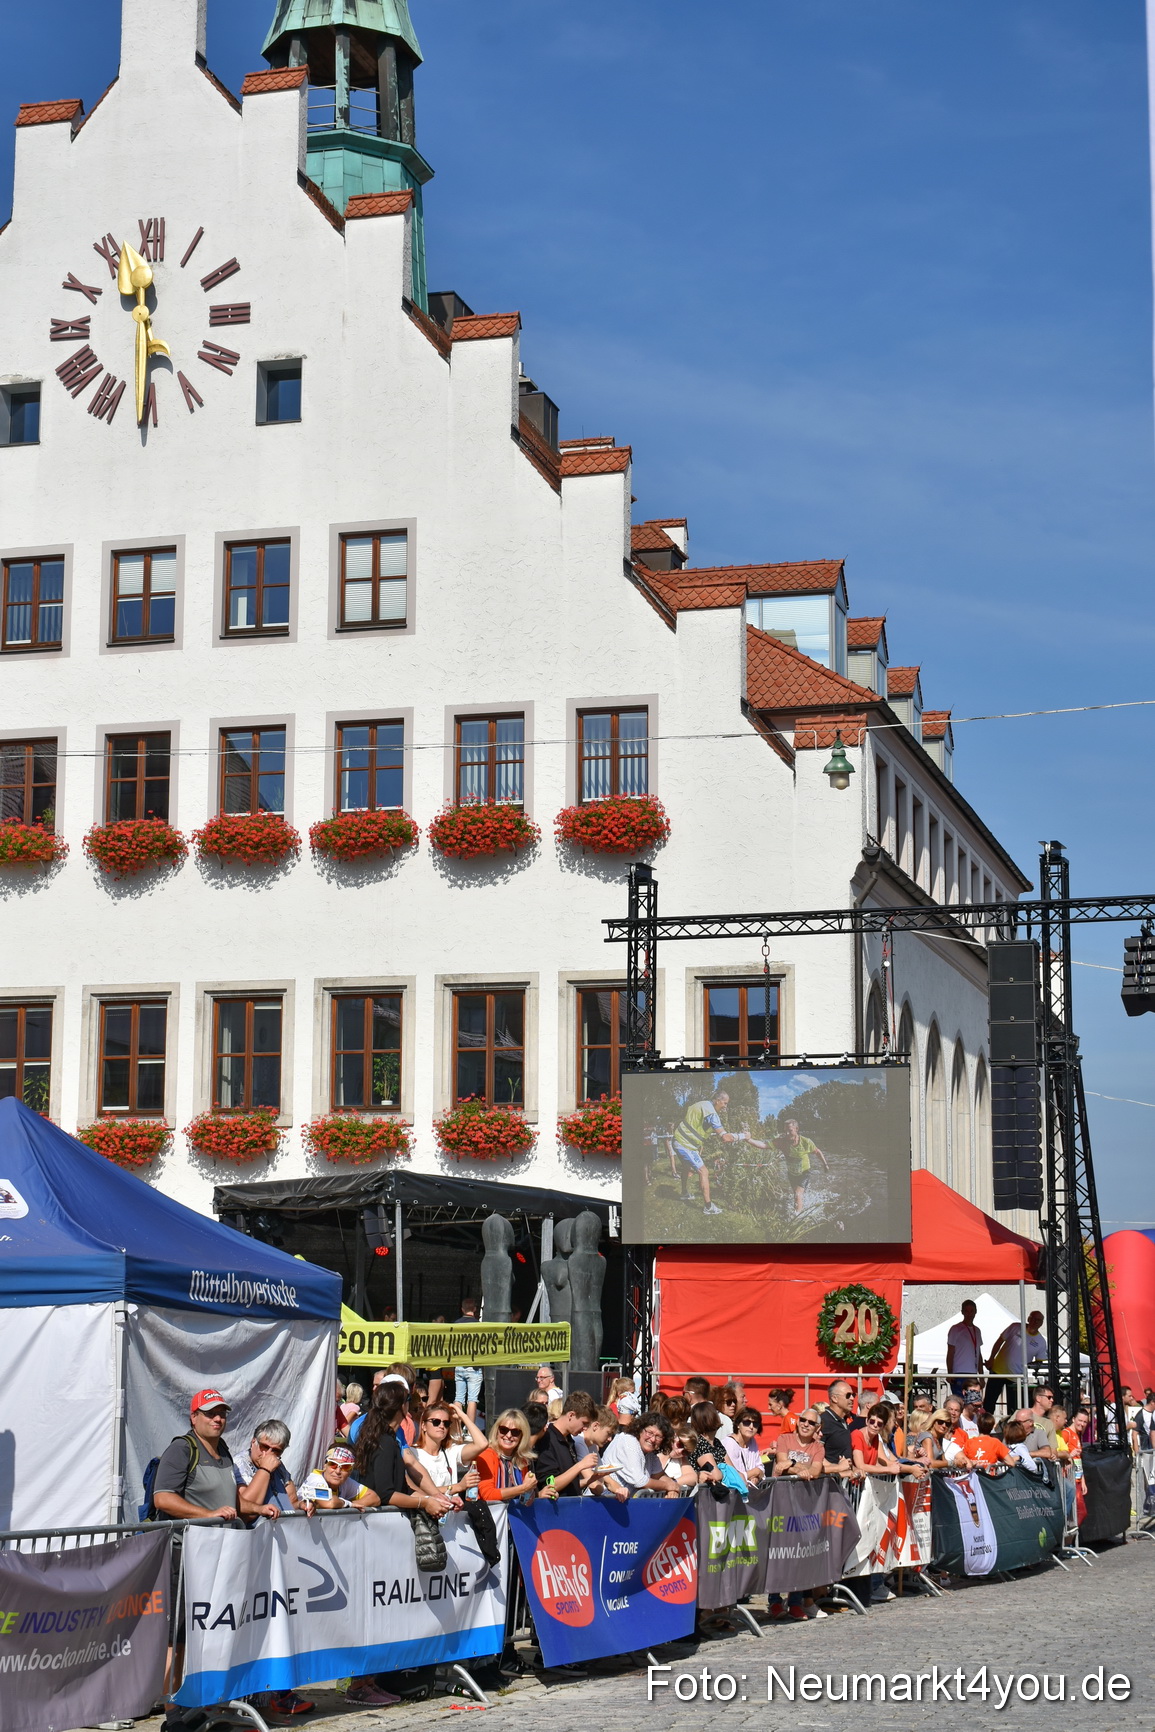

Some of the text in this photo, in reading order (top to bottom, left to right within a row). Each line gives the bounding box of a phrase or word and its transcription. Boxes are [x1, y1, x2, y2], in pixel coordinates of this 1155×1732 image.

[62, 272, 102, 305] X
[209, 302, 251, 327] III
[189, 1270, 299, 1308] Mittelbayerische
[833, 1302, 879, 1343] 20
[410, 1326, 567, 1362] www.jumpers-fitness.com
[612, 1541, 639, 1554] STORE
[373, 1572, 470, 1608] RAIL.ONE
[536, 1550, 590, 1607] Hervis
[658, 1579, 687, 1597] SPORTS
[19, 1605, 109, 1634] INDUSTRY
[106, 1590, 164, 1625] LOUNGE
[555, 1600, 580, 1615] SPORTS
